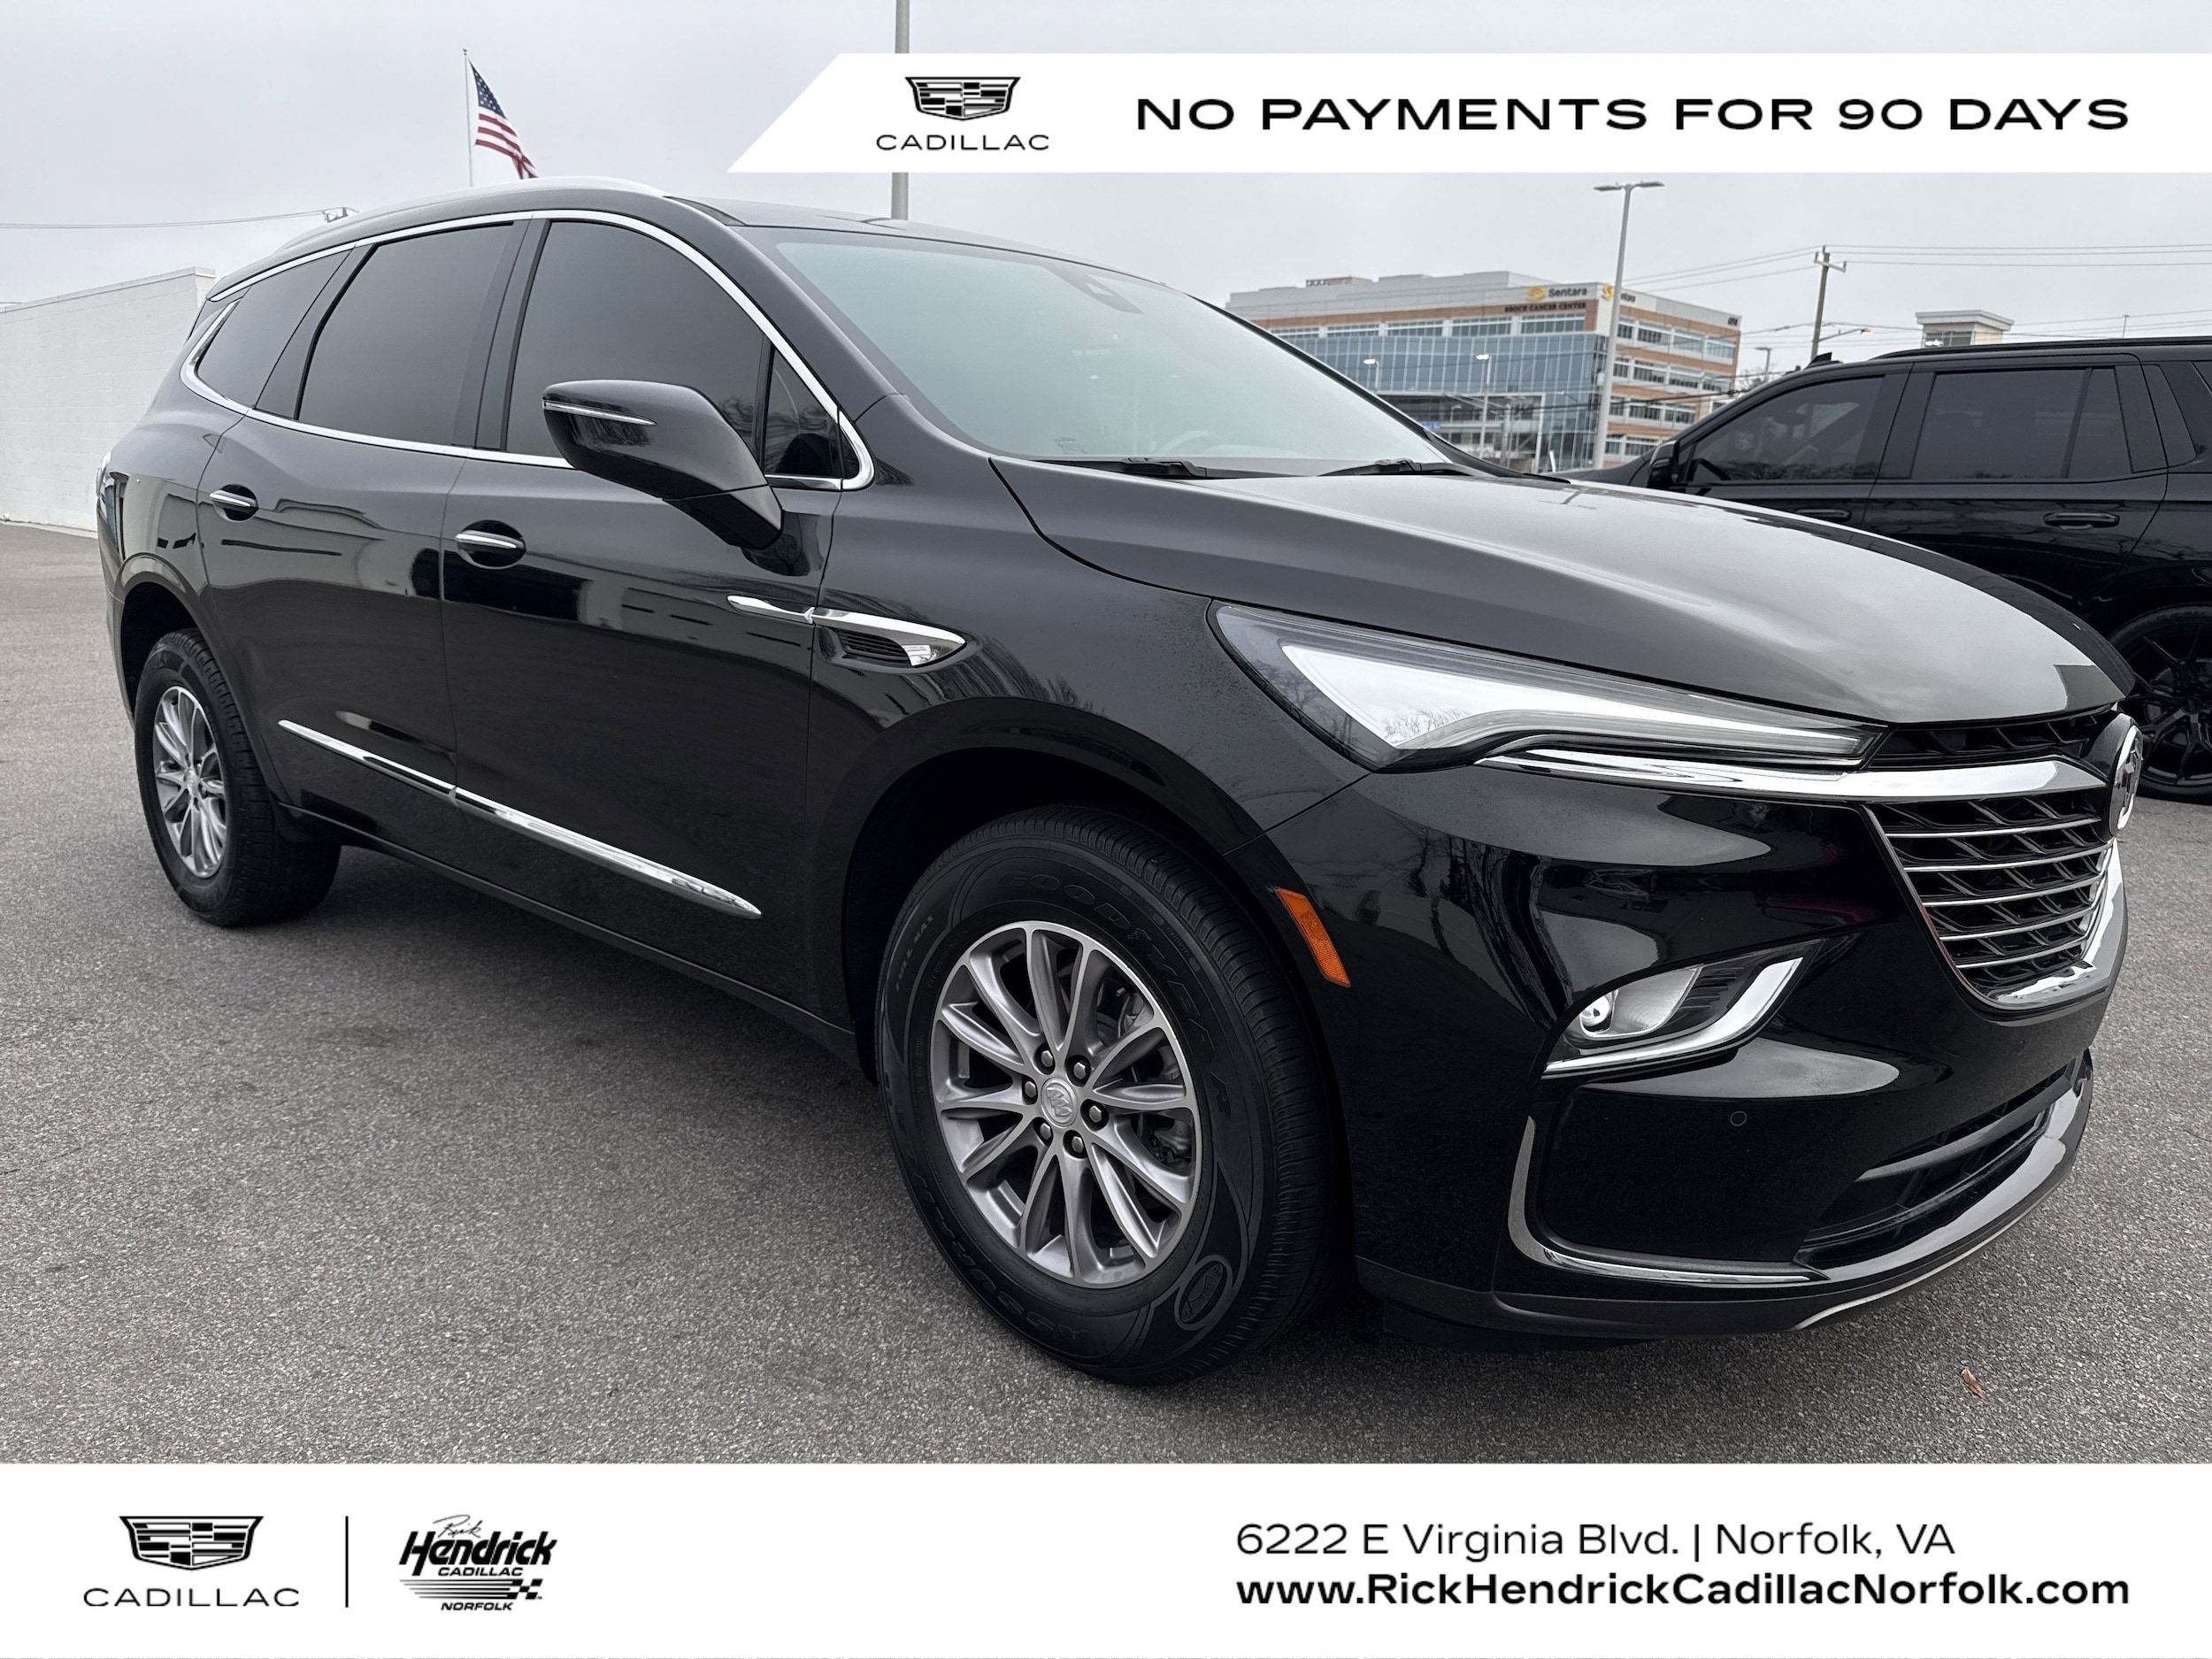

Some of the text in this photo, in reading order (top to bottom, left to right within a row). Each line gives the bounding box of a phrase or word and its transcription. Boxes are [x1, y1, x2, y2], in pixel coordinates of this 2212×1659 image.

[1548, 288, 1587, 298] Sentara
[1505, 304, 1527, 313] BROCK
[998, 871, 1231, 1118] GOODYEAR
